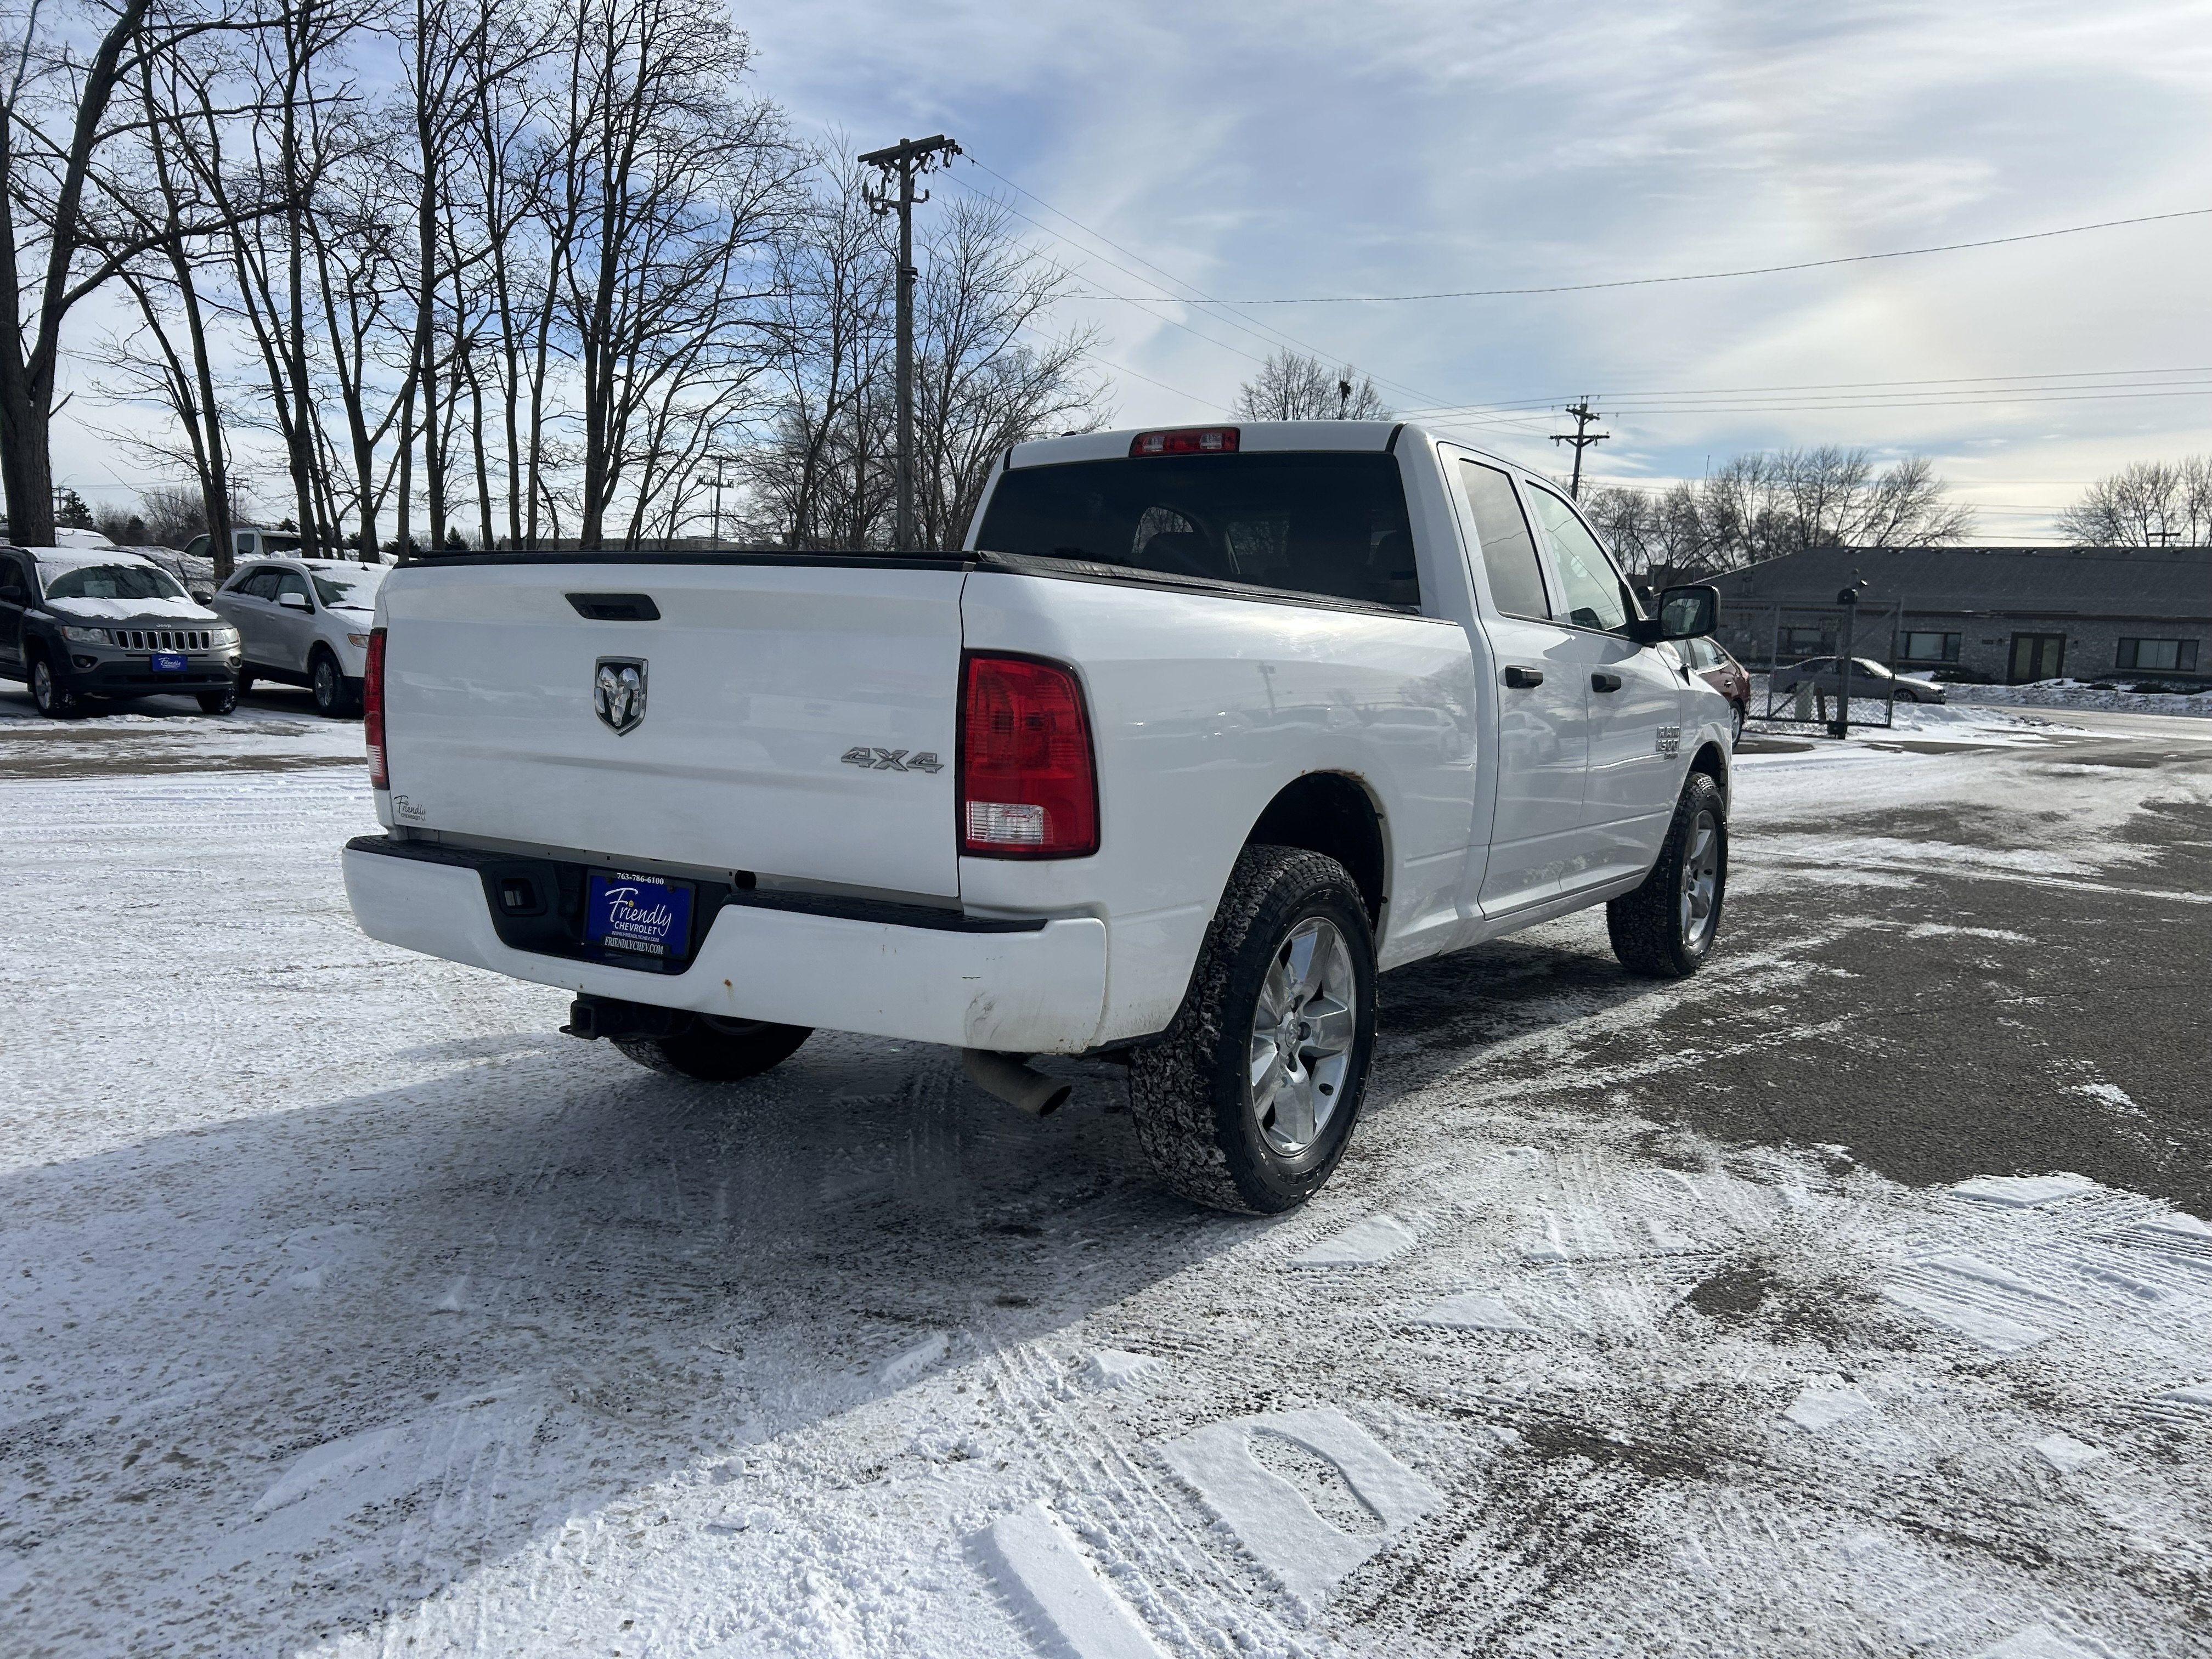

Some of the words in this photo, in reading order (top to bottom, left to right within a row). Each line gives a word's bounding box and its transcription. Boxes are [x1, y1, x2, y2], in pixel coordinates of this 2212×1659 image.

[1657, 726, 1679, 738] RAM
[1656, 739, 1678, 752] 1500
[840, 747, 944, 774] 4X4
[393, 795, 426, 821] Friendly
[617, 872, 664, 885] 763-786-6100
[605, 887, 672, 936] Friendly
[614, 921, 657, 935] CHEVROLET
[605, 936, 664, 955] FRIENDLYCHEV.COM
